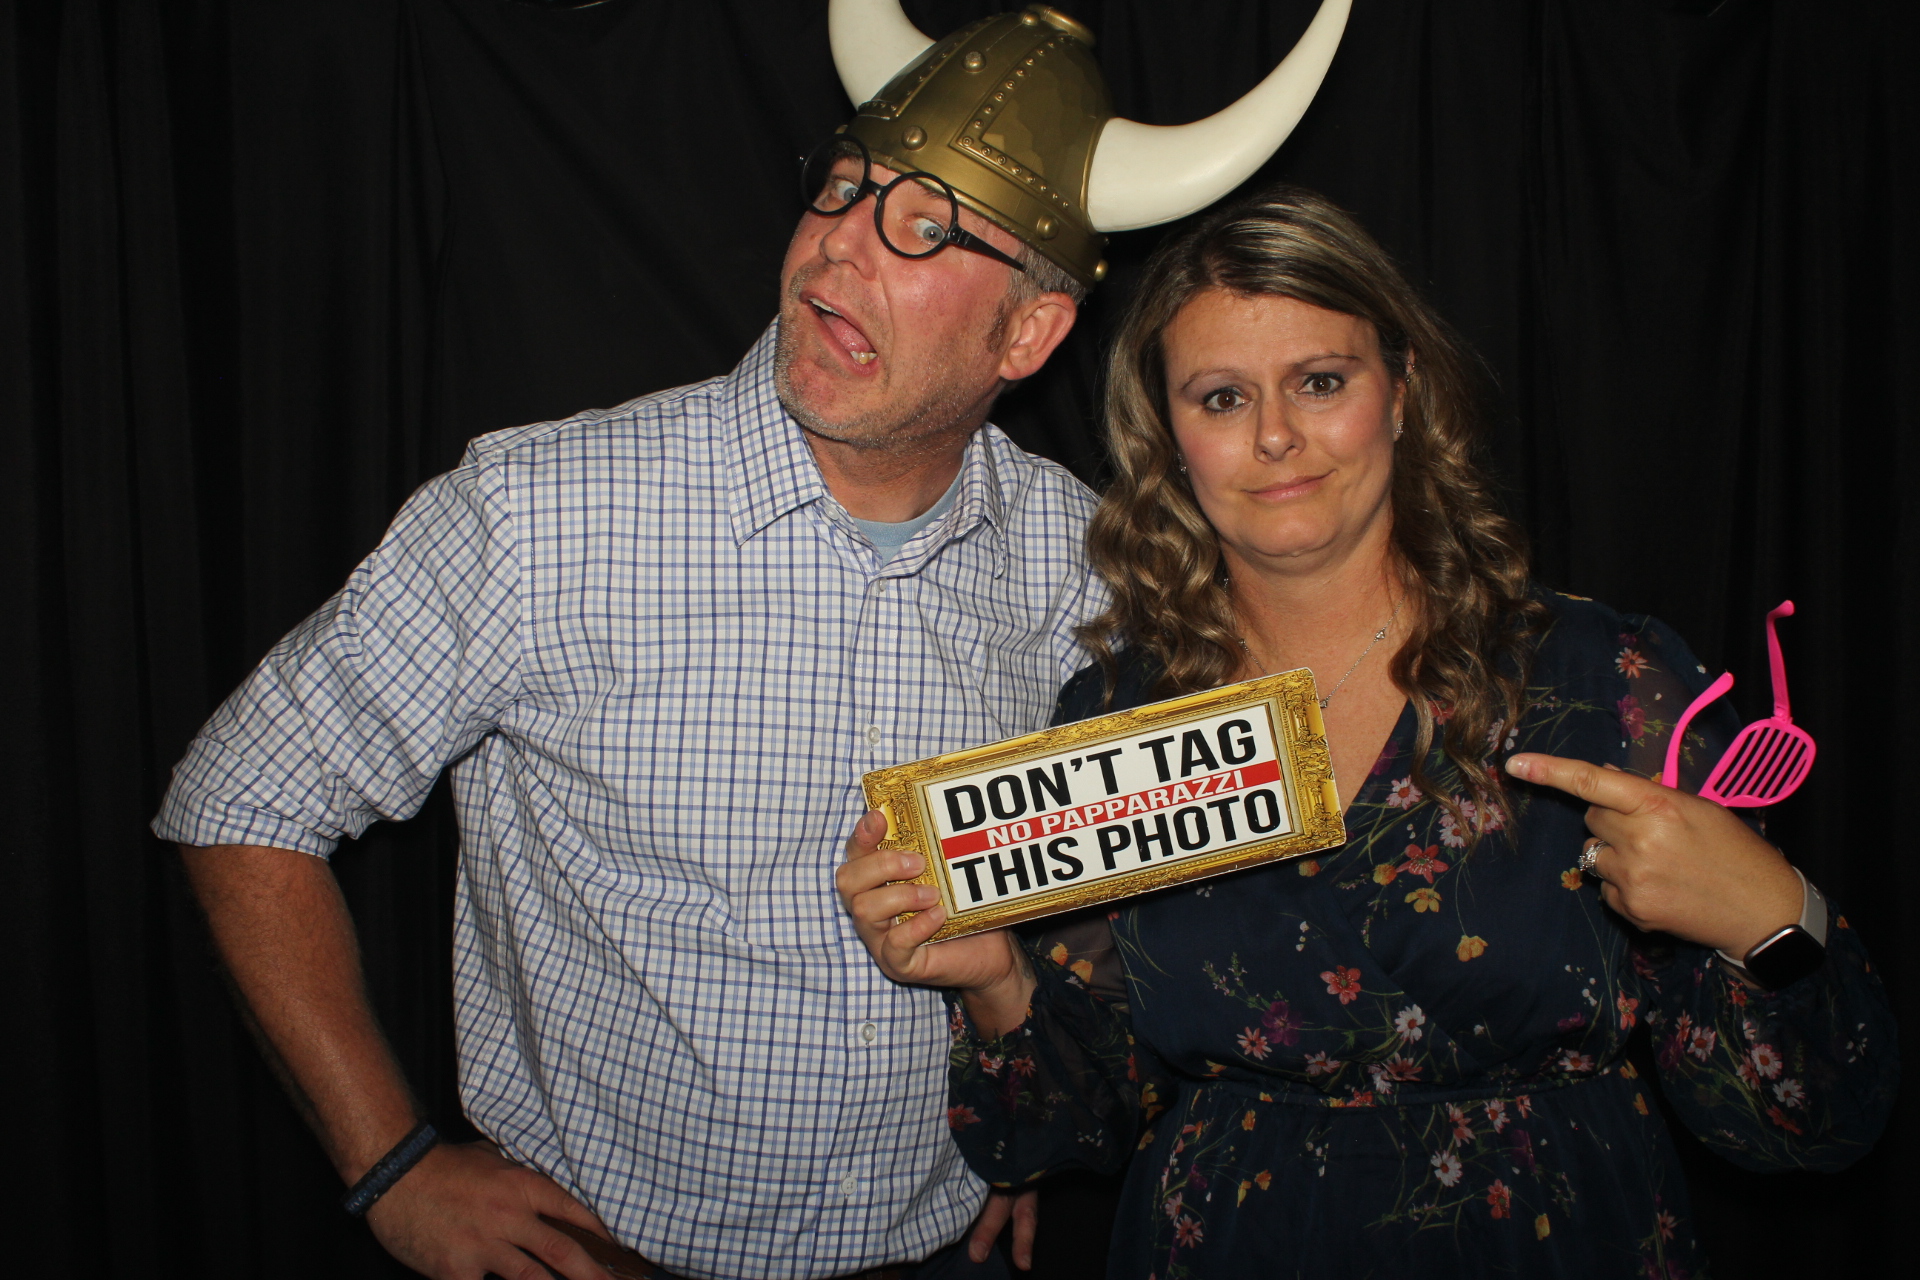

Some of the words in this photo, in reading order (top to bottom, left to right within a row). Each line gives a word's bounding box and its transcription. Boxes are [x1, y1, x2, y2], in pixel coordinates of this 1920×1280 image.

[944, 748, 1124, 832] DON'T
[1138, 718, 1257, 784] TAG
[986, 820, 1032, 848] NO
[1042, 771, 1245, 831] PAPPARAZZI
[952, 836, 1084, 903] THIS
[1096, 788, 1282, 871] PHOTO
